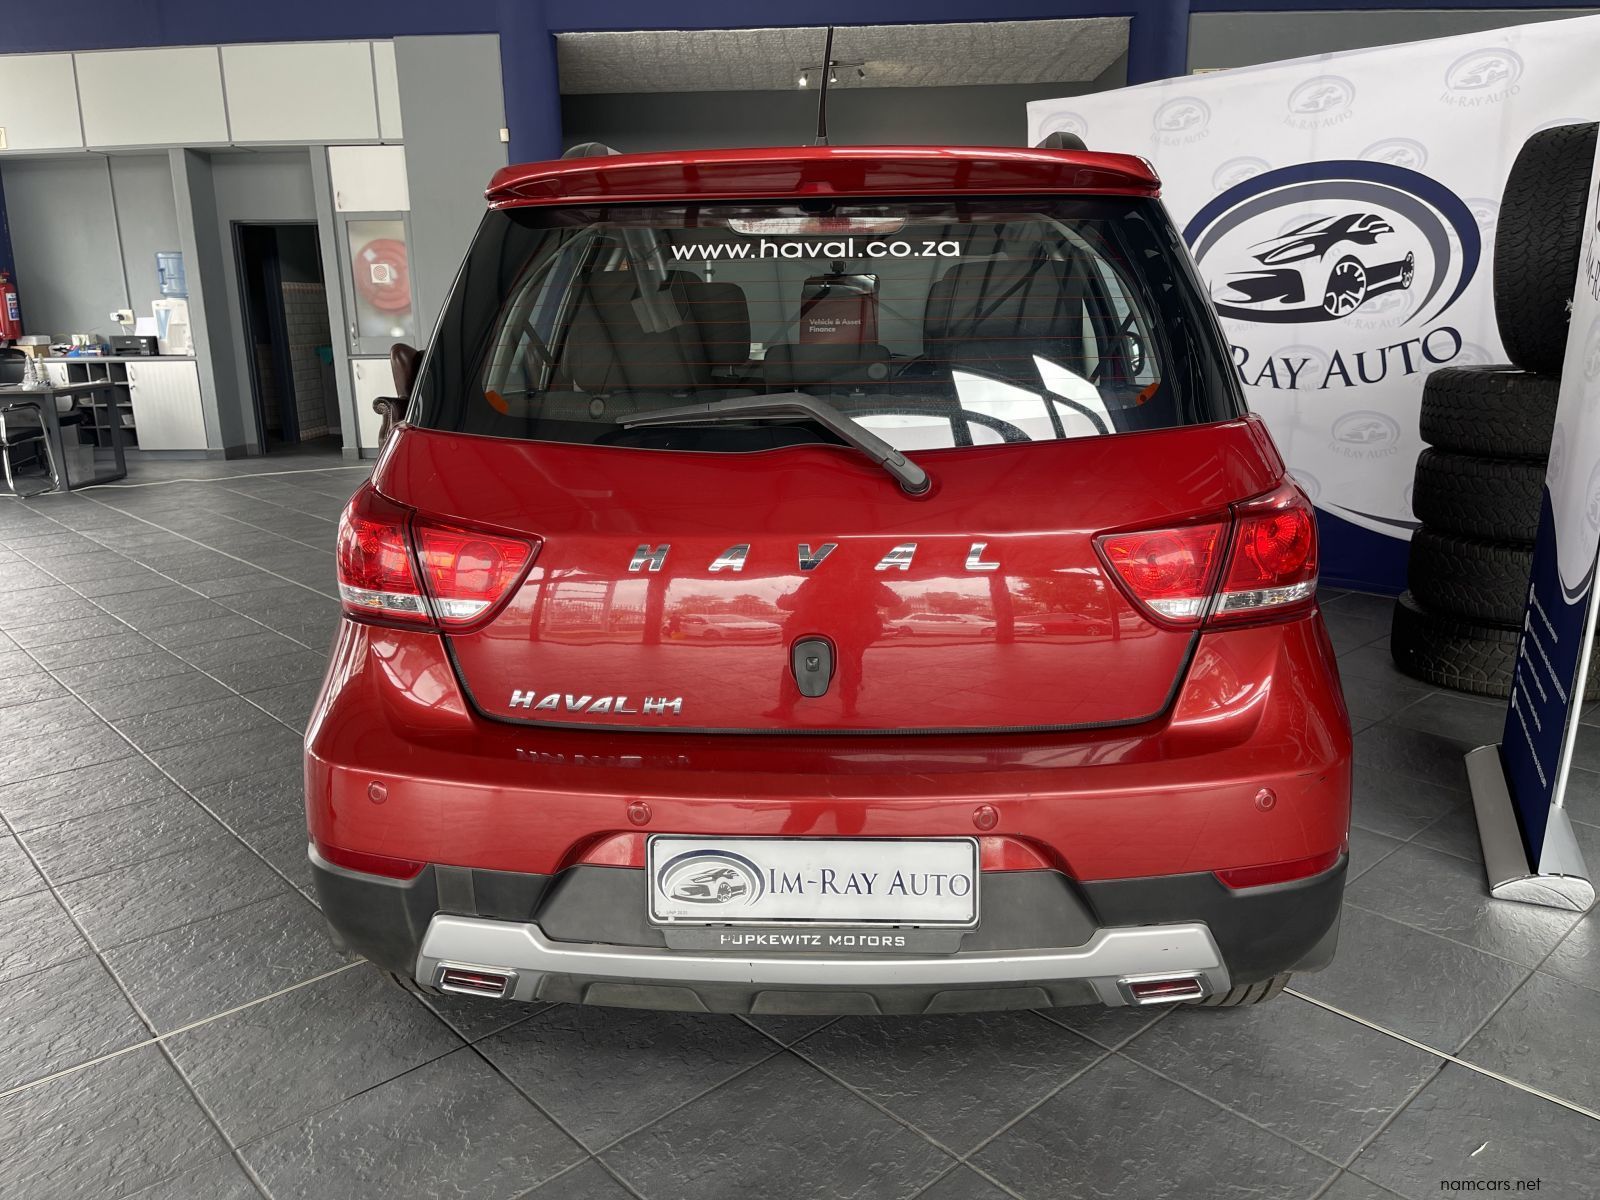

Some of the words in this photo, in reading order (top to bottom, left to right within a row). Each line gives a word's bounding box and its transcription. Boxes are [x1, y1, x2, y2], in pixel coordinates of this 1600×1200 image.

[671, 238, 960, 260] www.haval.co.za
[1317, 326, 1463, 390] AUTO
[628, 543, 1001, 572] HAVAL
[509, 690, 637, 714] HAVAL
[643, 697, 683, 716] H1
[768, 868, 878, 895] IM-RAY
[888, 870, 972, 897] AUTO
[829, 935, 906, 947] MOTORS
